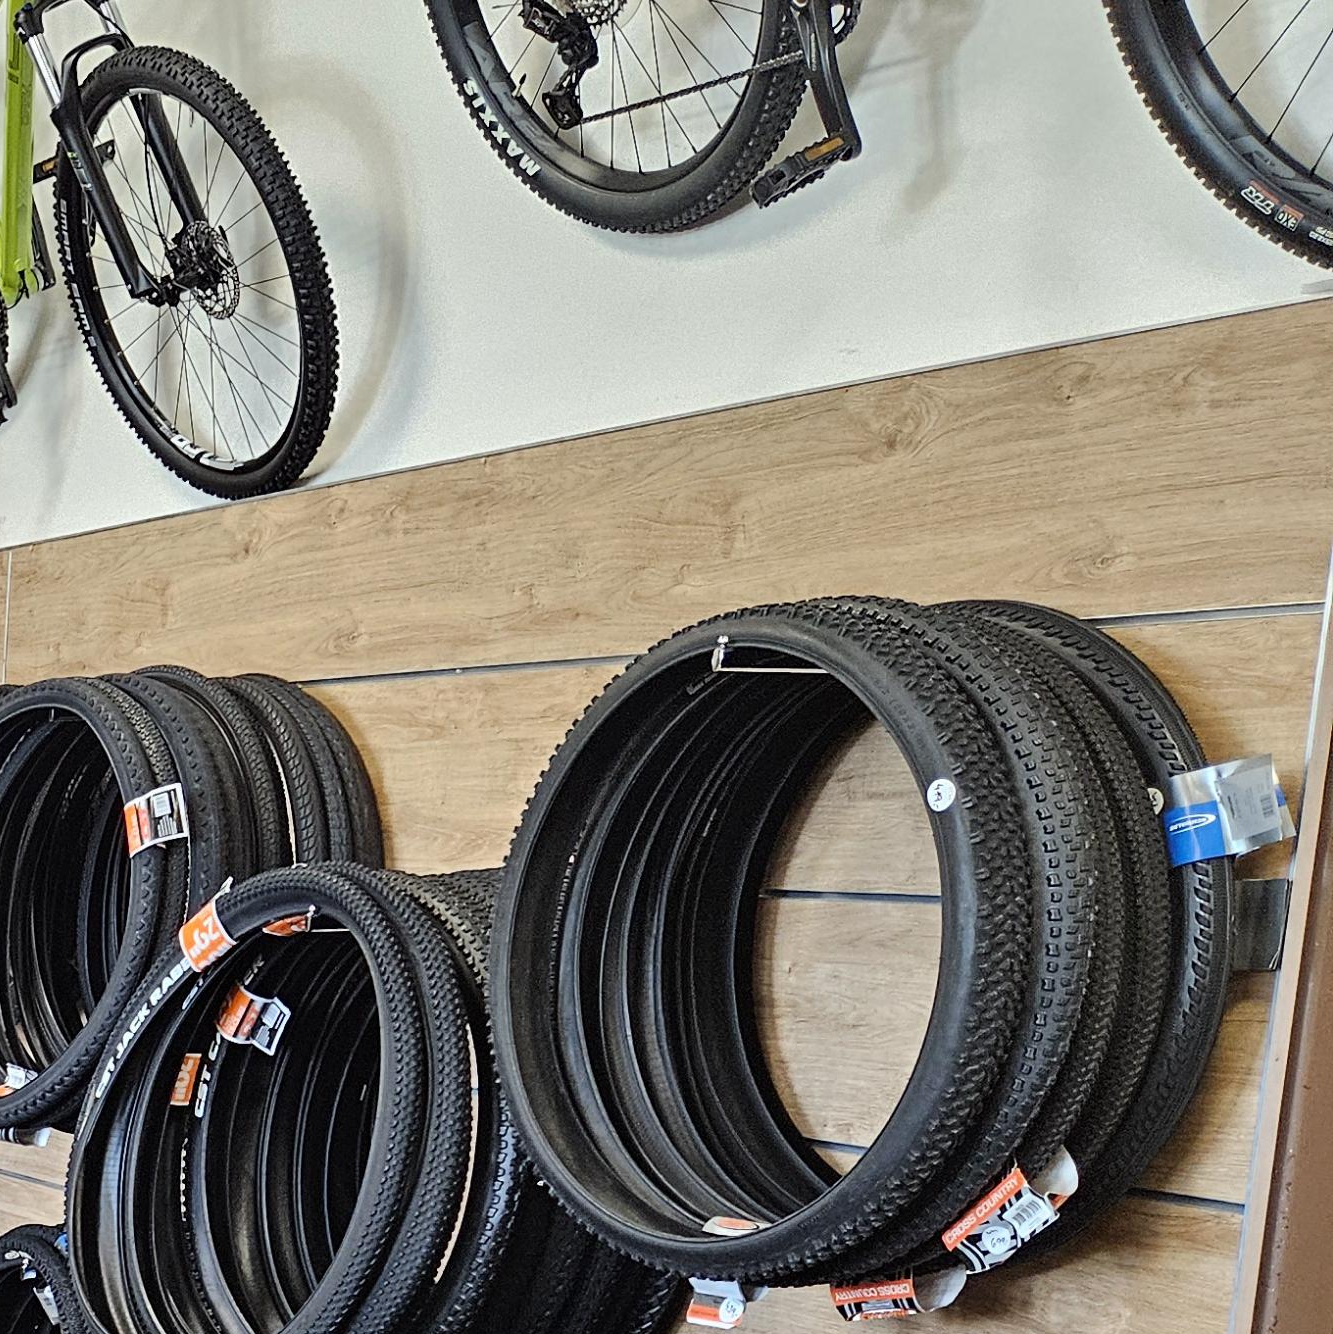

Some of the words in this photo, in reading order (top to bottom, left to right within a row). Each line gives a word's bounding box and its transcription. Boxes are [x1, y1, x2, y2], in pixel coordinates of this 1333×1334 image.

[462, 76, 532, 177] MAXXIS
[95, 1056, 116, 1099] CST
[116, 1003, 151, 1060] JACK
[195, 1064, 211, 1118] CST
[944, 1215, 976, 1245] CROSS
[975, 1177, 1020, 1218] COUNTRY
[834, 1286, 878, 1302] COUNTRY
[877, 1283, 910, 1297] CROSS
